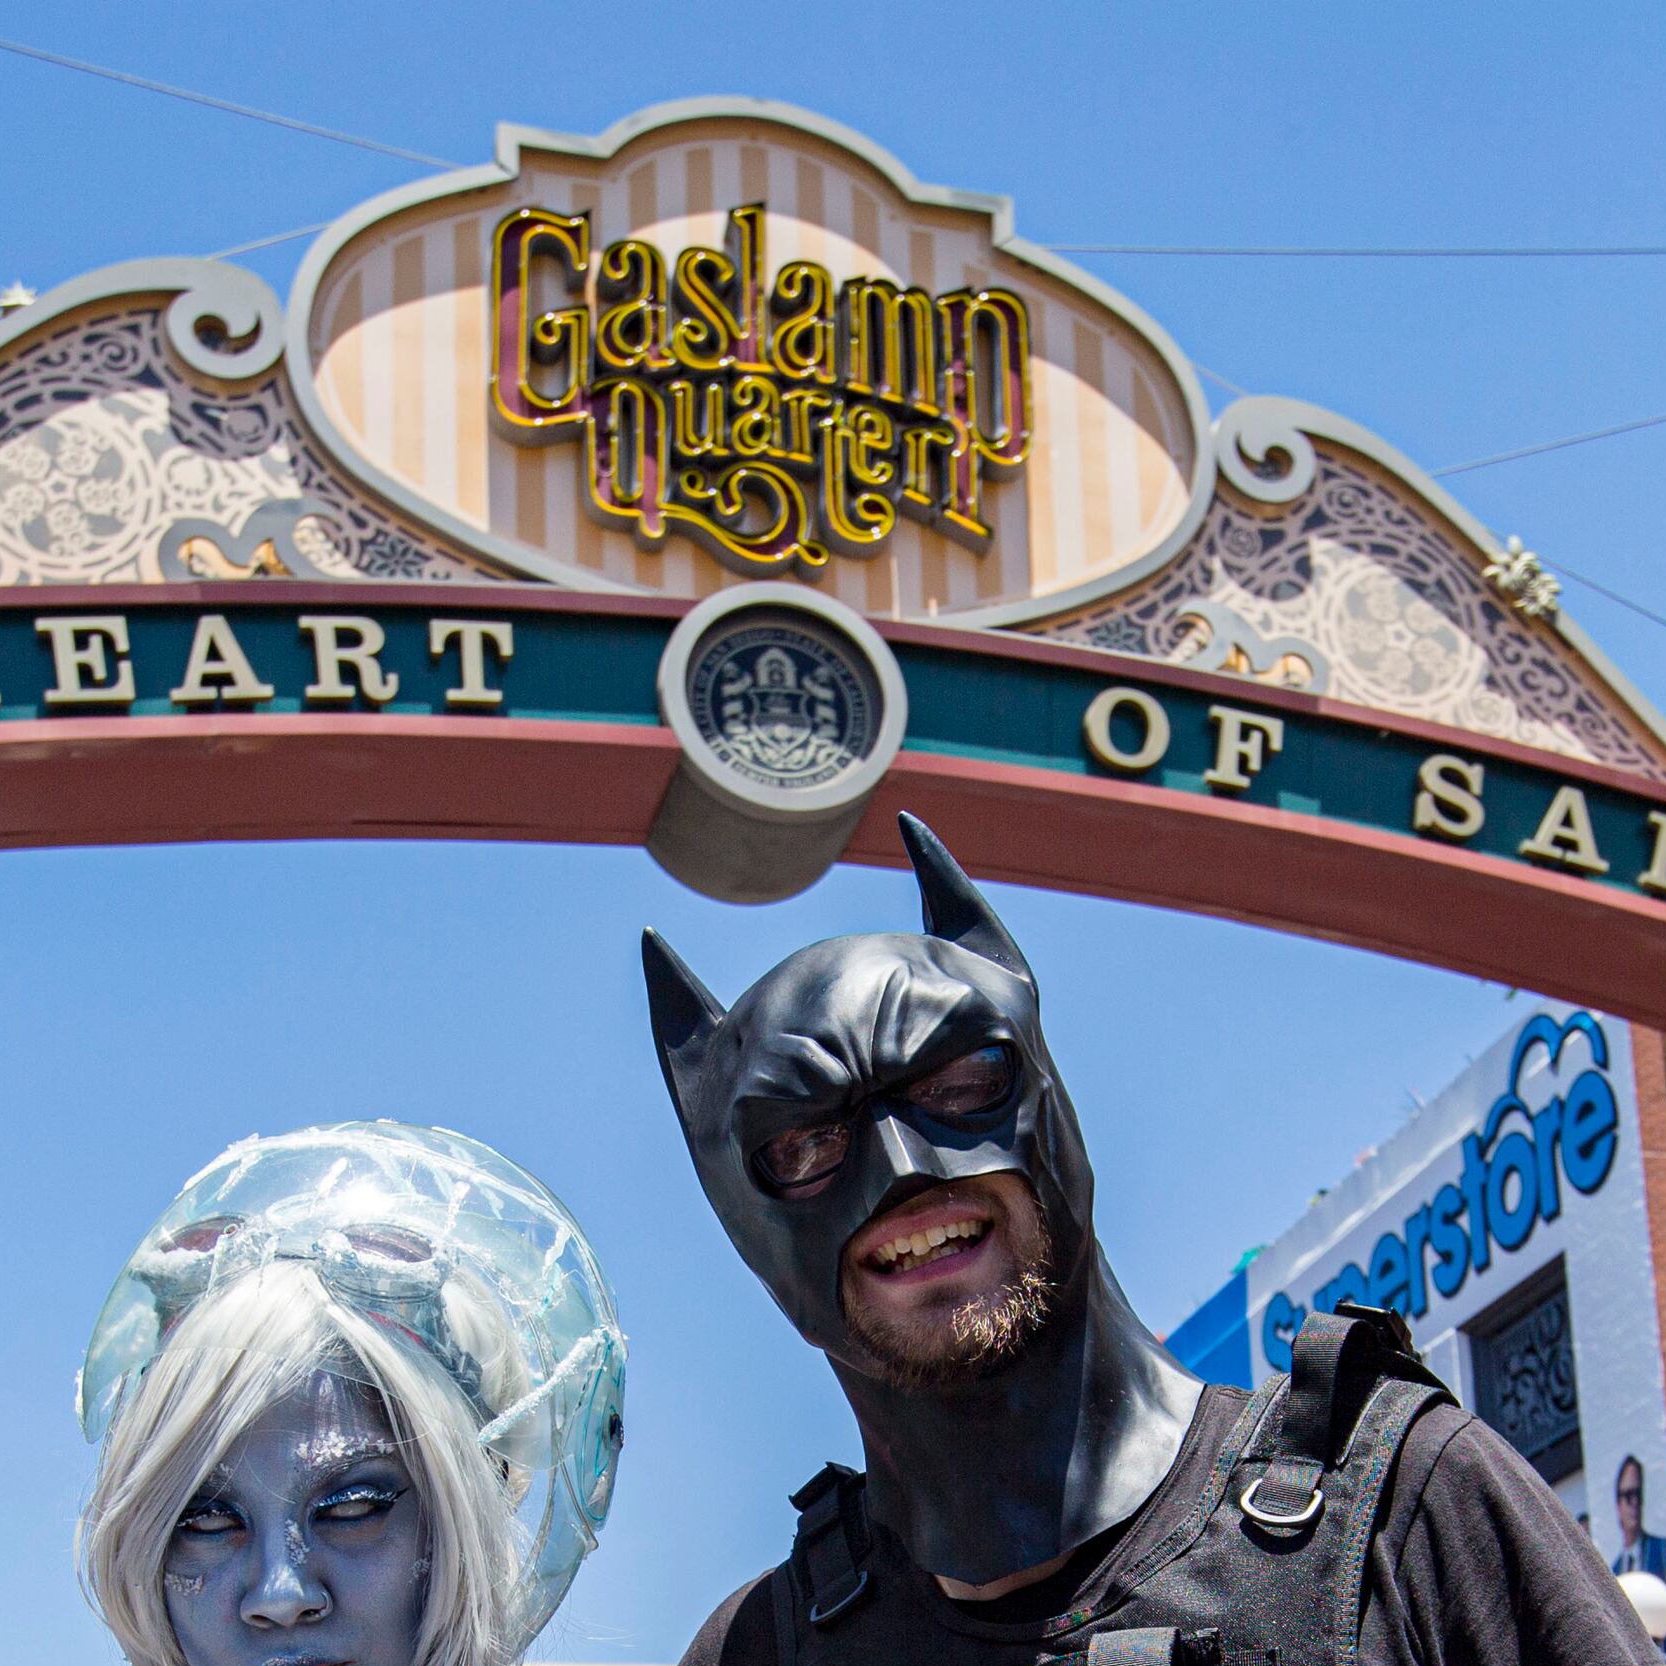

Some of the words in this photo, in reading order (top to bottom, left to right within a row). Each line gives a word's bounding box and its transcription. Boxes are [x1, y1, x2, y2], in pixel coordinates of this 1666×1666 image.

[490, 200, 1035, 548] Gaslamp
[587, 372, 960, 572] Quarter
[1082, 686, 1285, 790] OF
